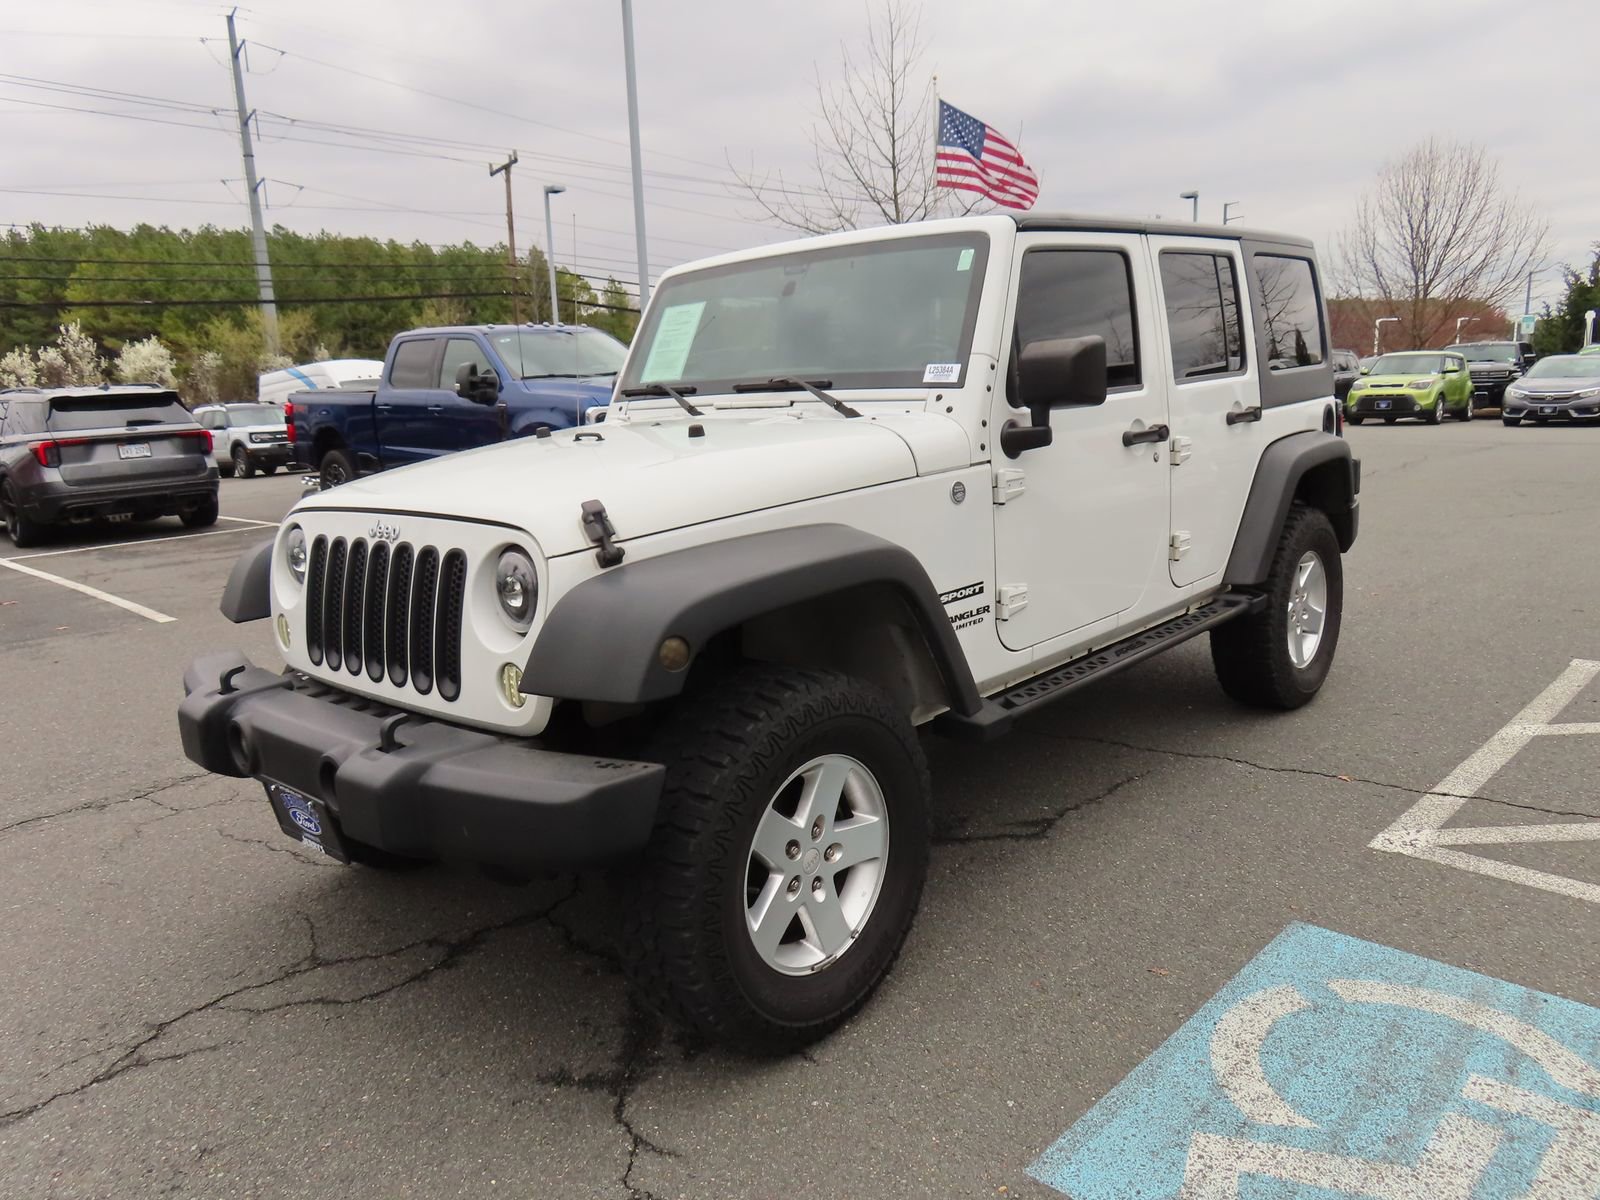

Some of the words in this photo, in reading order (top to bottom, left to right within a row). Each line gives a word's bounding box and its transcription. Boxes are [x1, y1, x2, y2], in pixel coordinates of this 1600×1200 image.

[369, 519, 400, 544] Jeep
[940, 584, 984, 603] SPORT
[954, 617, 984, 630] IMITED
[296, 811, 317, 832] Ford
